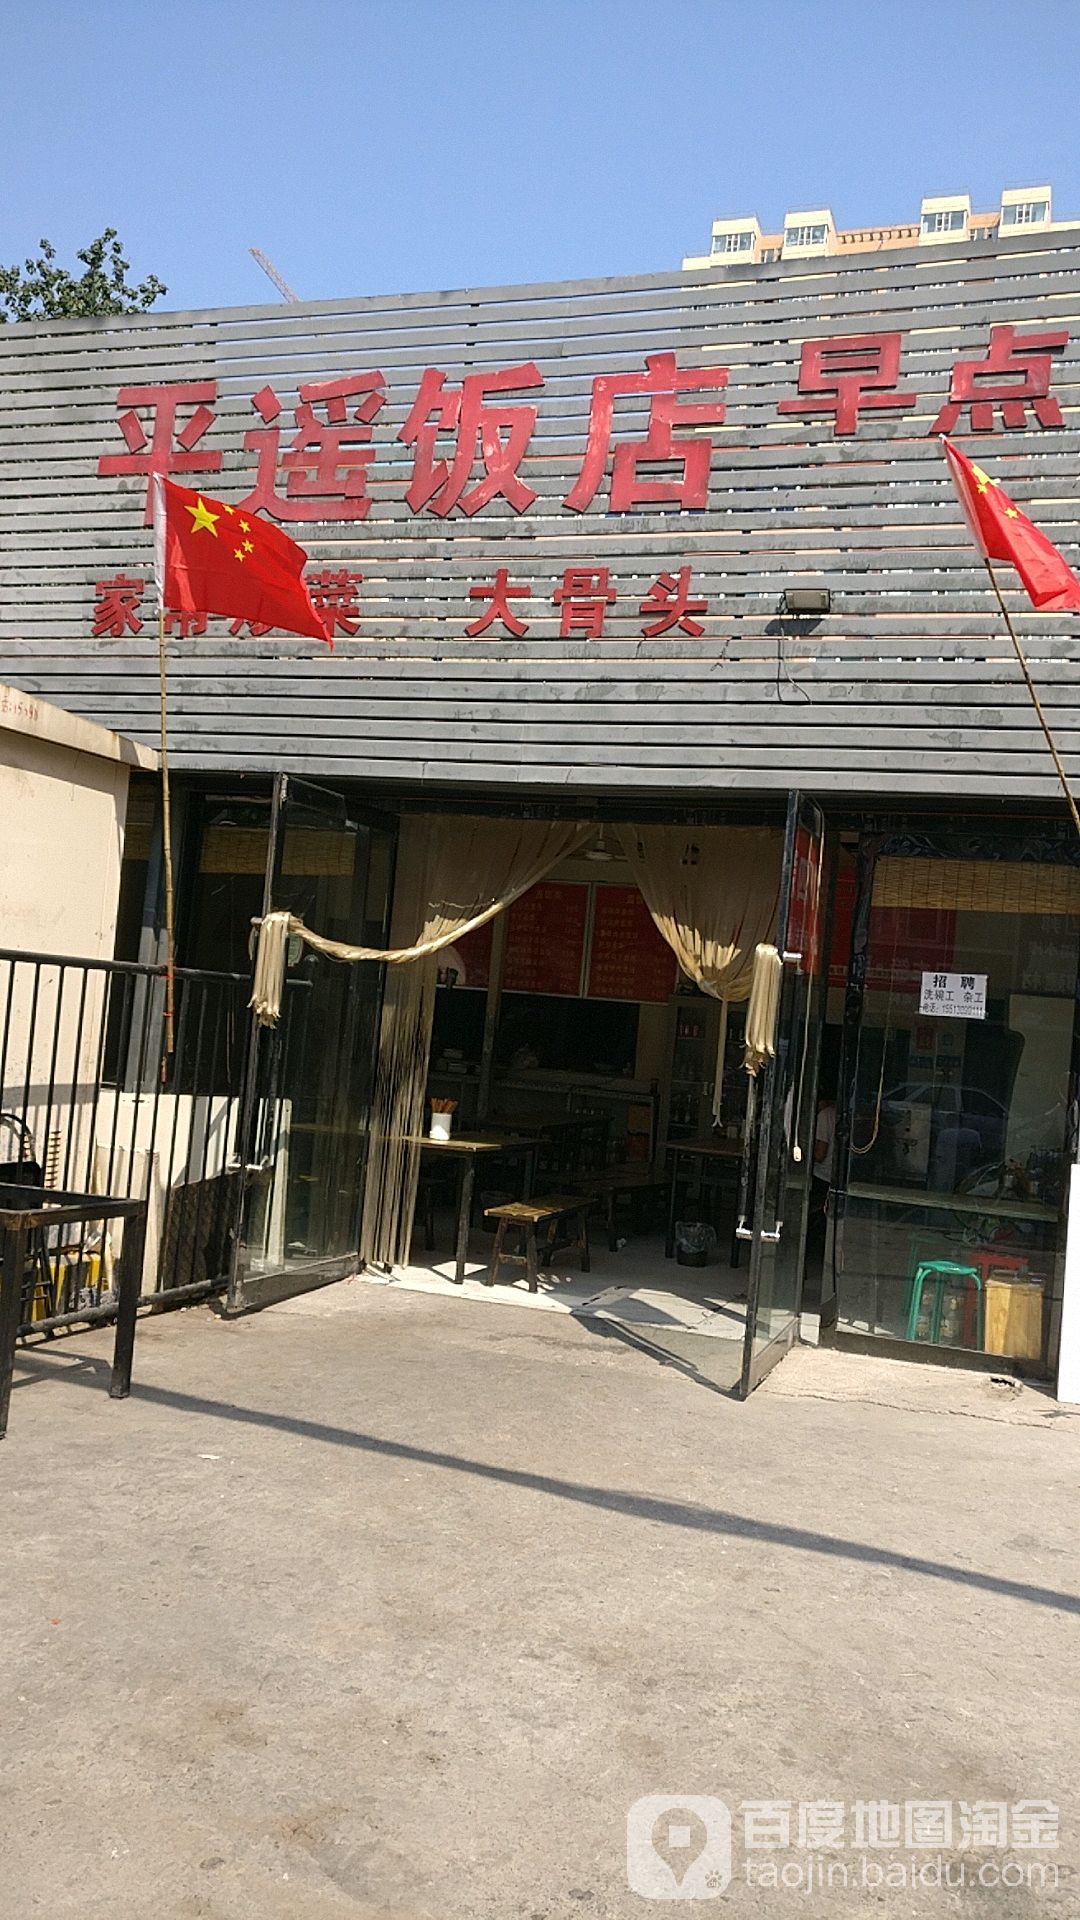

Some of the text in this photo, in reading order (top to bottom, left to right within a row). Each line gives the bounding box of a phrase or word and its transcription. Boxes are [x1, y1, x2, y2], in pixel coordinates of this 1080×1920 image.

[98, 325, 1069, 525] 平遥饭店 早点
[91, 566, 708, 637] 家菜 大骨头
